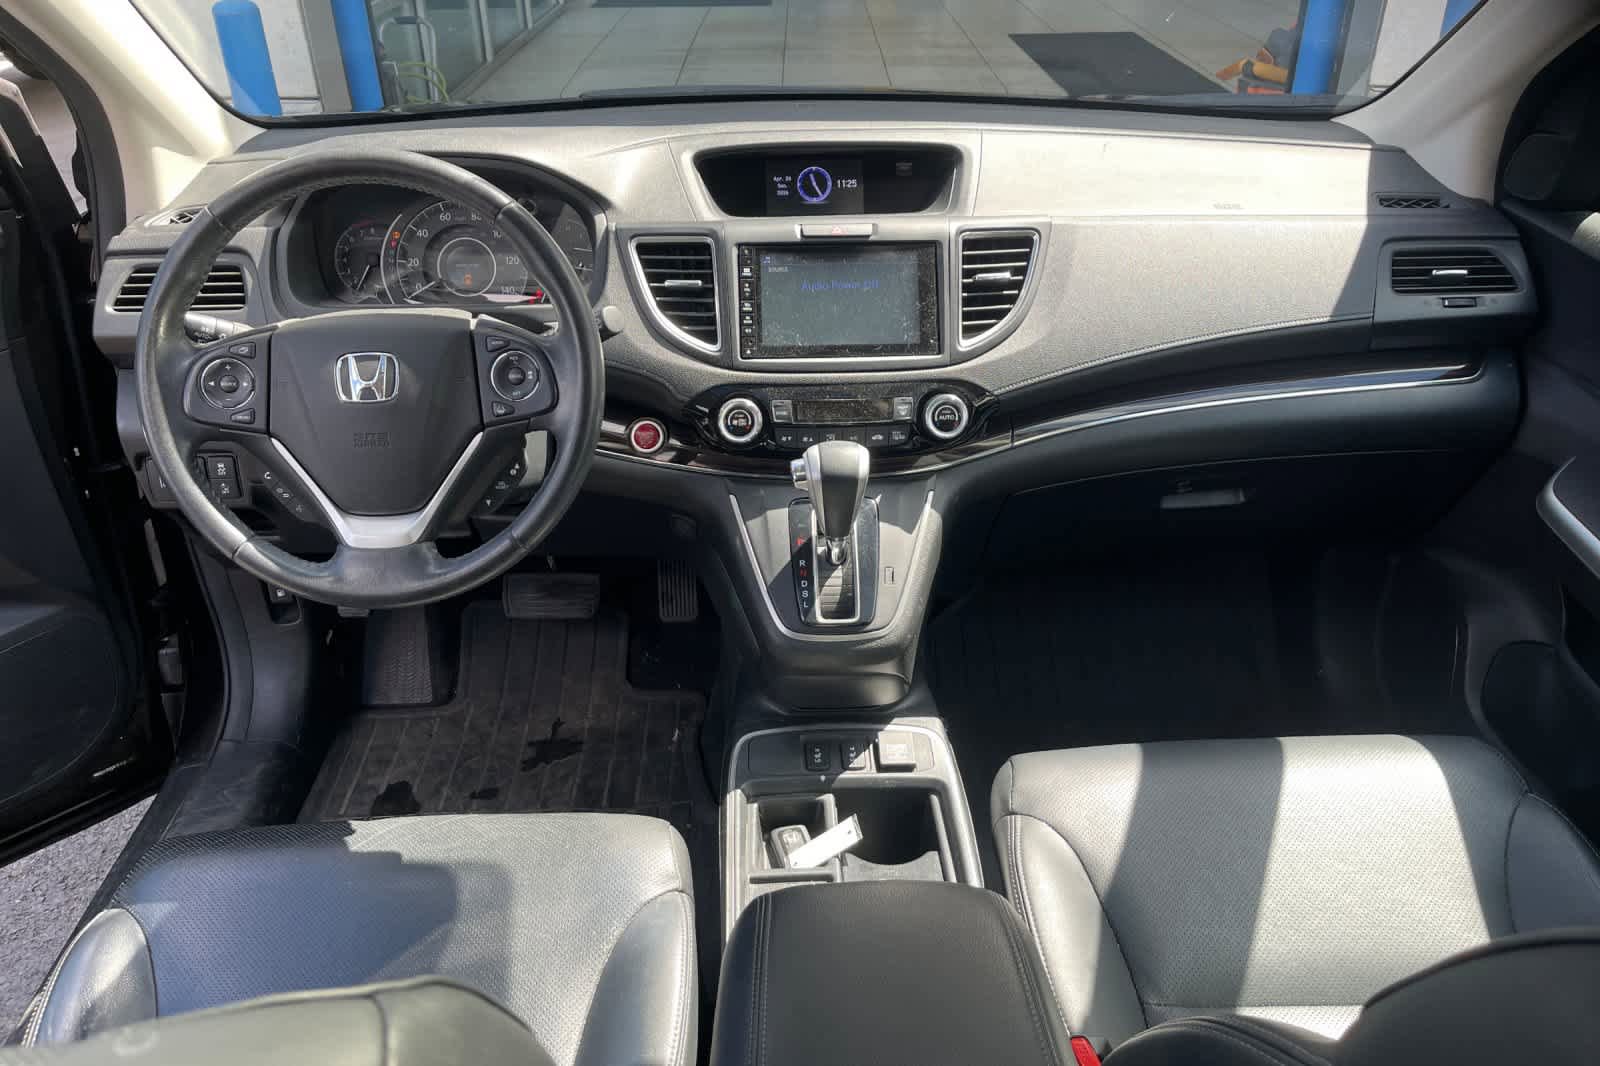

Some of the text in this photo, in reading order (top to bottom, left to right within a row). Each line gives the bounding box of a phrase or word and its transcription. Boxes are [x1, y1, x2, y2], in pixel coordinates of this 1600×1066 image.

[440, 212, 451, 222] 60
[416, 229, 429, 238] 40
[408, 258, 419, 267] 20
[506, 256, 519, 265] 120
[799, 559, 806, 567] R
[802, 590, 809, 598] S
